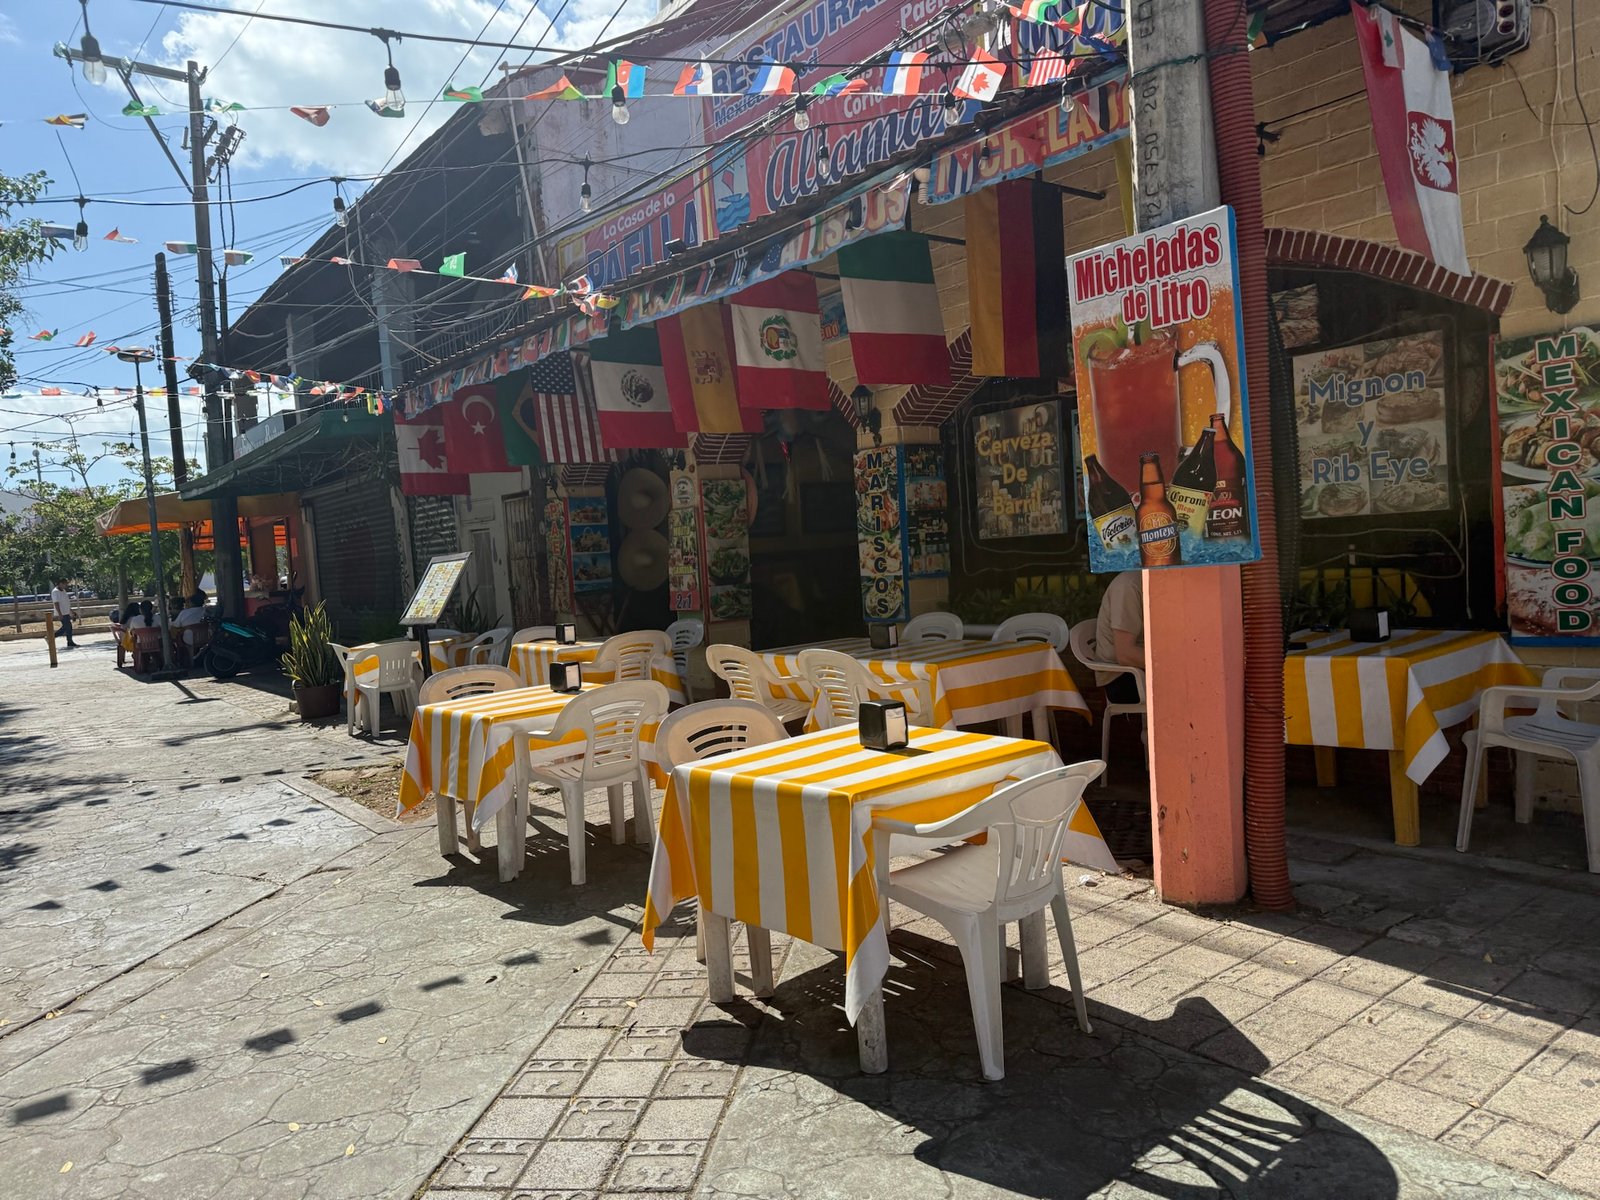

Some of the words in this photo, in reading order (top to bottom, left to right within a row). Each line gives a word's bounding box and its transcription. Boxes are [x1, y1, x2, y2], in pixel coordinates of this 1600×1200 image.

[603, 224, 617, 240] La
[617, 209, 644, 232] Casa
[645, 200, 661, 217] de
[663, 192, 675, 209] la
[587, 199, 699, 290] PAELLA
[1074, 222, 1221, 303] Micheladas
[1123, 289, 1148, 324] de
[1150, 277, 1212, 328] Litro
[1308, 370, 1426, 407] Mignon
[976, 430, 1052, 457] Cerveza
[1357, 419, 1375, 447] y
[1534, 333, 1586, 520] MEXICAN
[1003, 464, 1028, 485] De
[1312, 453, 1361, 484] Rib
[1370, 451, 1429, 485] Eye
[993, 492, 1042, 516] Barril
[1170, 490, 1206, 507] Corona
[1206, 507, 1242, 521] LEON
[866, 451, 889, 615] MARISCOS
[1102, 515, 1136, 542] Victoria
[1141, 525, 1175, 543] Montejo
[1552, 530, 1590, 632] FOOD
